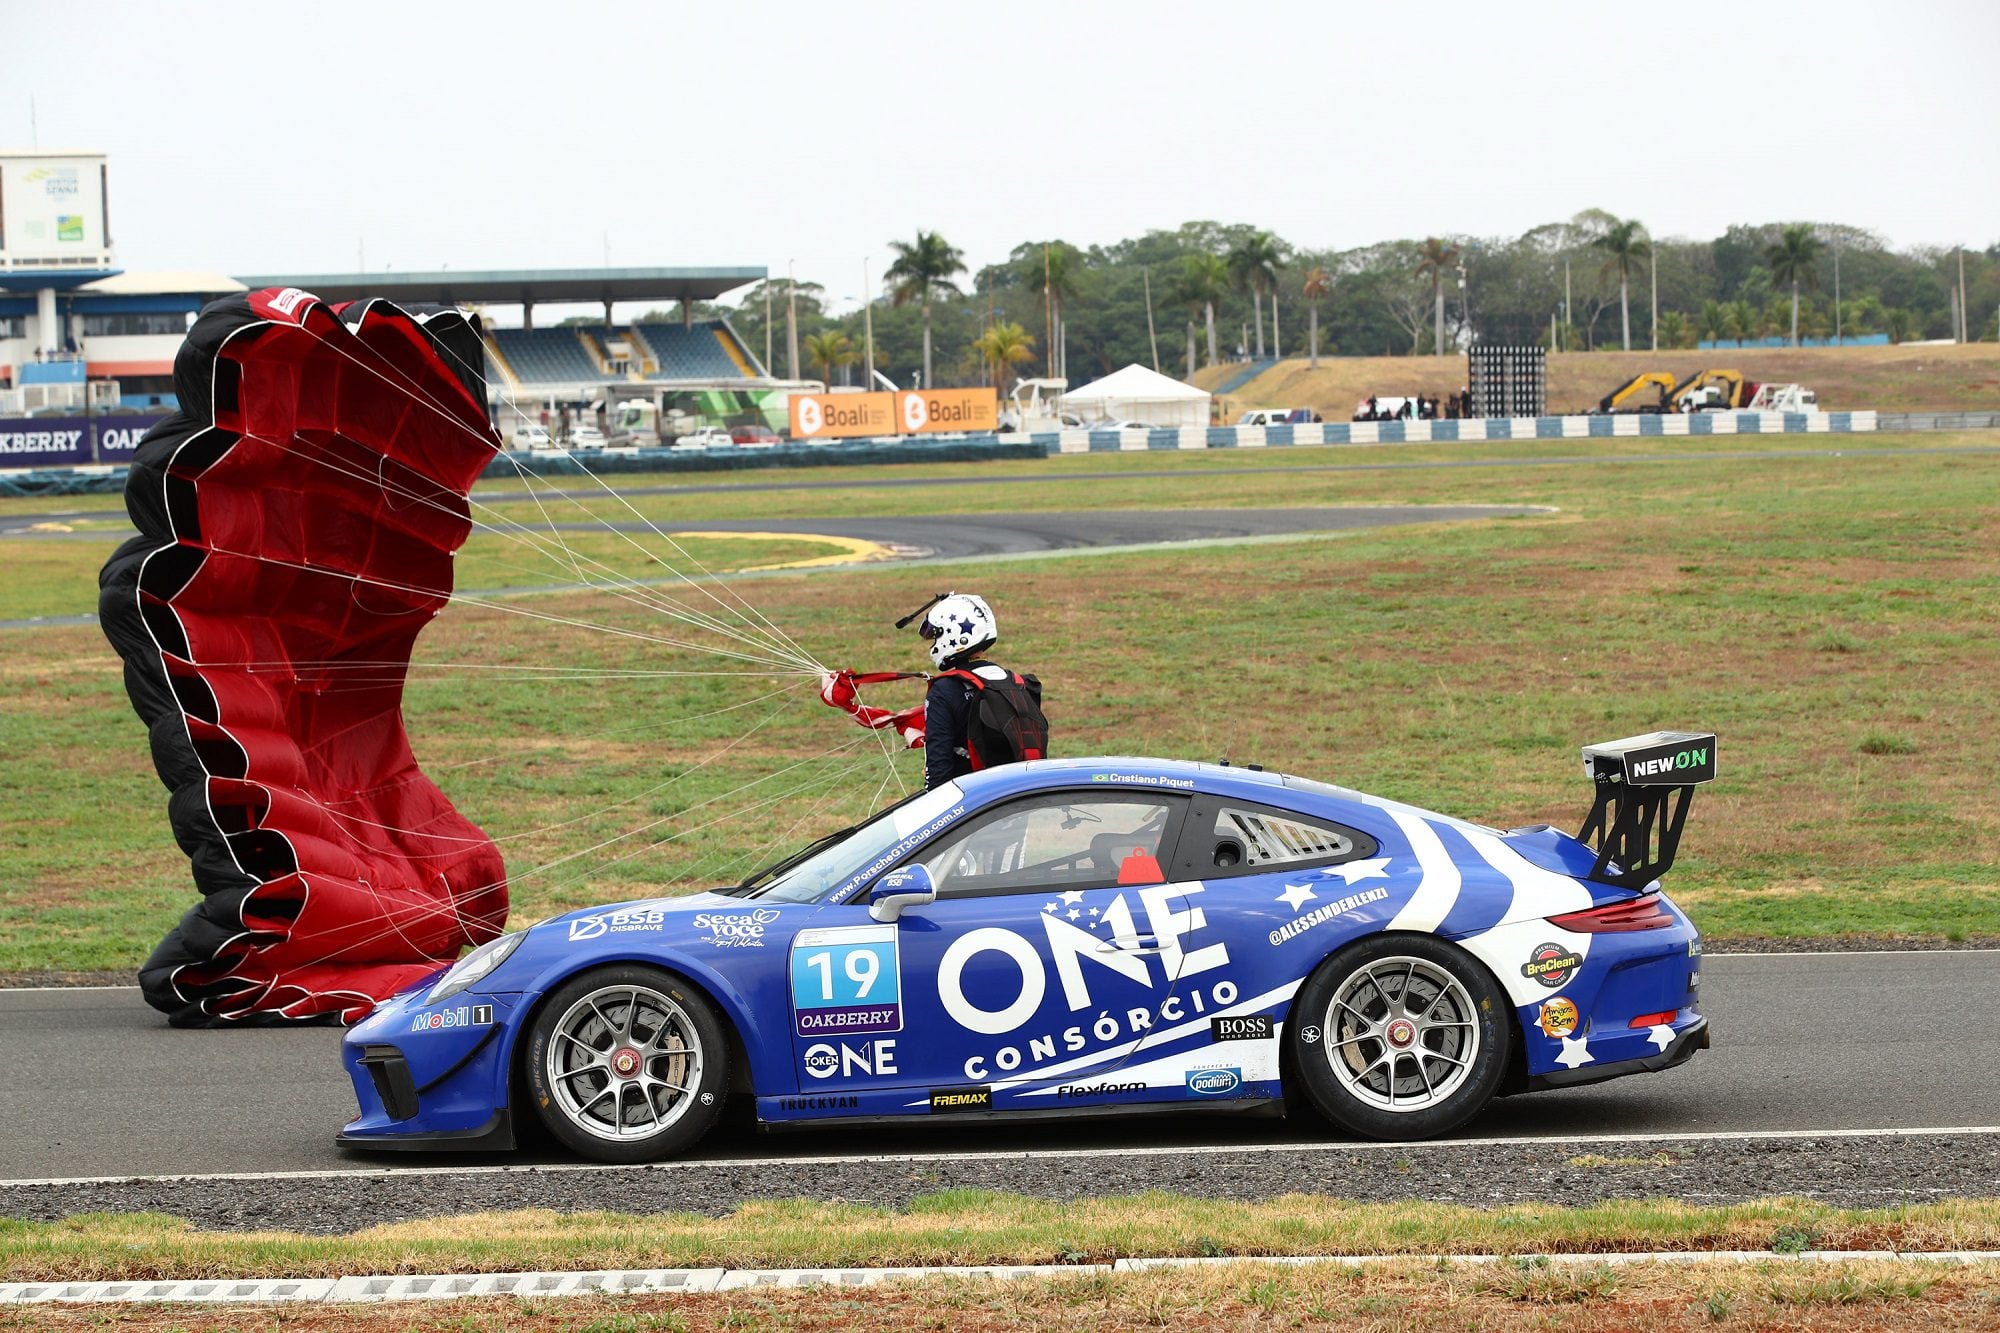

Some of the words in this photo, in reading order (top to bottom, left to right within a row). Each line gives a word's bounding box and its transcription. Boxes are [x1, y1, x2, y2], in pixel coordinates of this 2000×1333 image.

[824, 405, 868, 426] Boali
[929, 400, 971, 422] Boali
[1110, 773, 1157, 784] Cristiano
[1160, 776, 1194, 788] Piquet
[829, 805, 965, 903] www.PorscheGT3Cup.com.br
[611, 912, 665, 926] BSB
[693, 914, 755, 929] Seca
[1269, 887, 1389, 946] @ALESSANDERLENZI
[610, 924, 664, 933] DISBRAVE
[1527, 957, 1575, 975] BraClean
[807, 950, 880, 1001] 19
[412, 1007, 469, 1032] Mobil
[801, 1010, 894, 1029] OAKBERRY
[1544, 1006, 1573, 1017] Amigos
[1219, 1018, 1266, 1034] BOSS
[1550, 1016, 1576, 1027] Bem
[964, 981, 1238, 1080] CONSÓRCIO
[804, 1040, 898, 1079] ONE
[804, 1055, 839, 1067] TOKEN
[1057, 1082, 1147, 1099] Flexform
[1195, 1076, 1232, 1090] podium
[778, 1096, 859, 1111] TRUCKVAN
[933, 1093, 988, 1106] FREMAX
